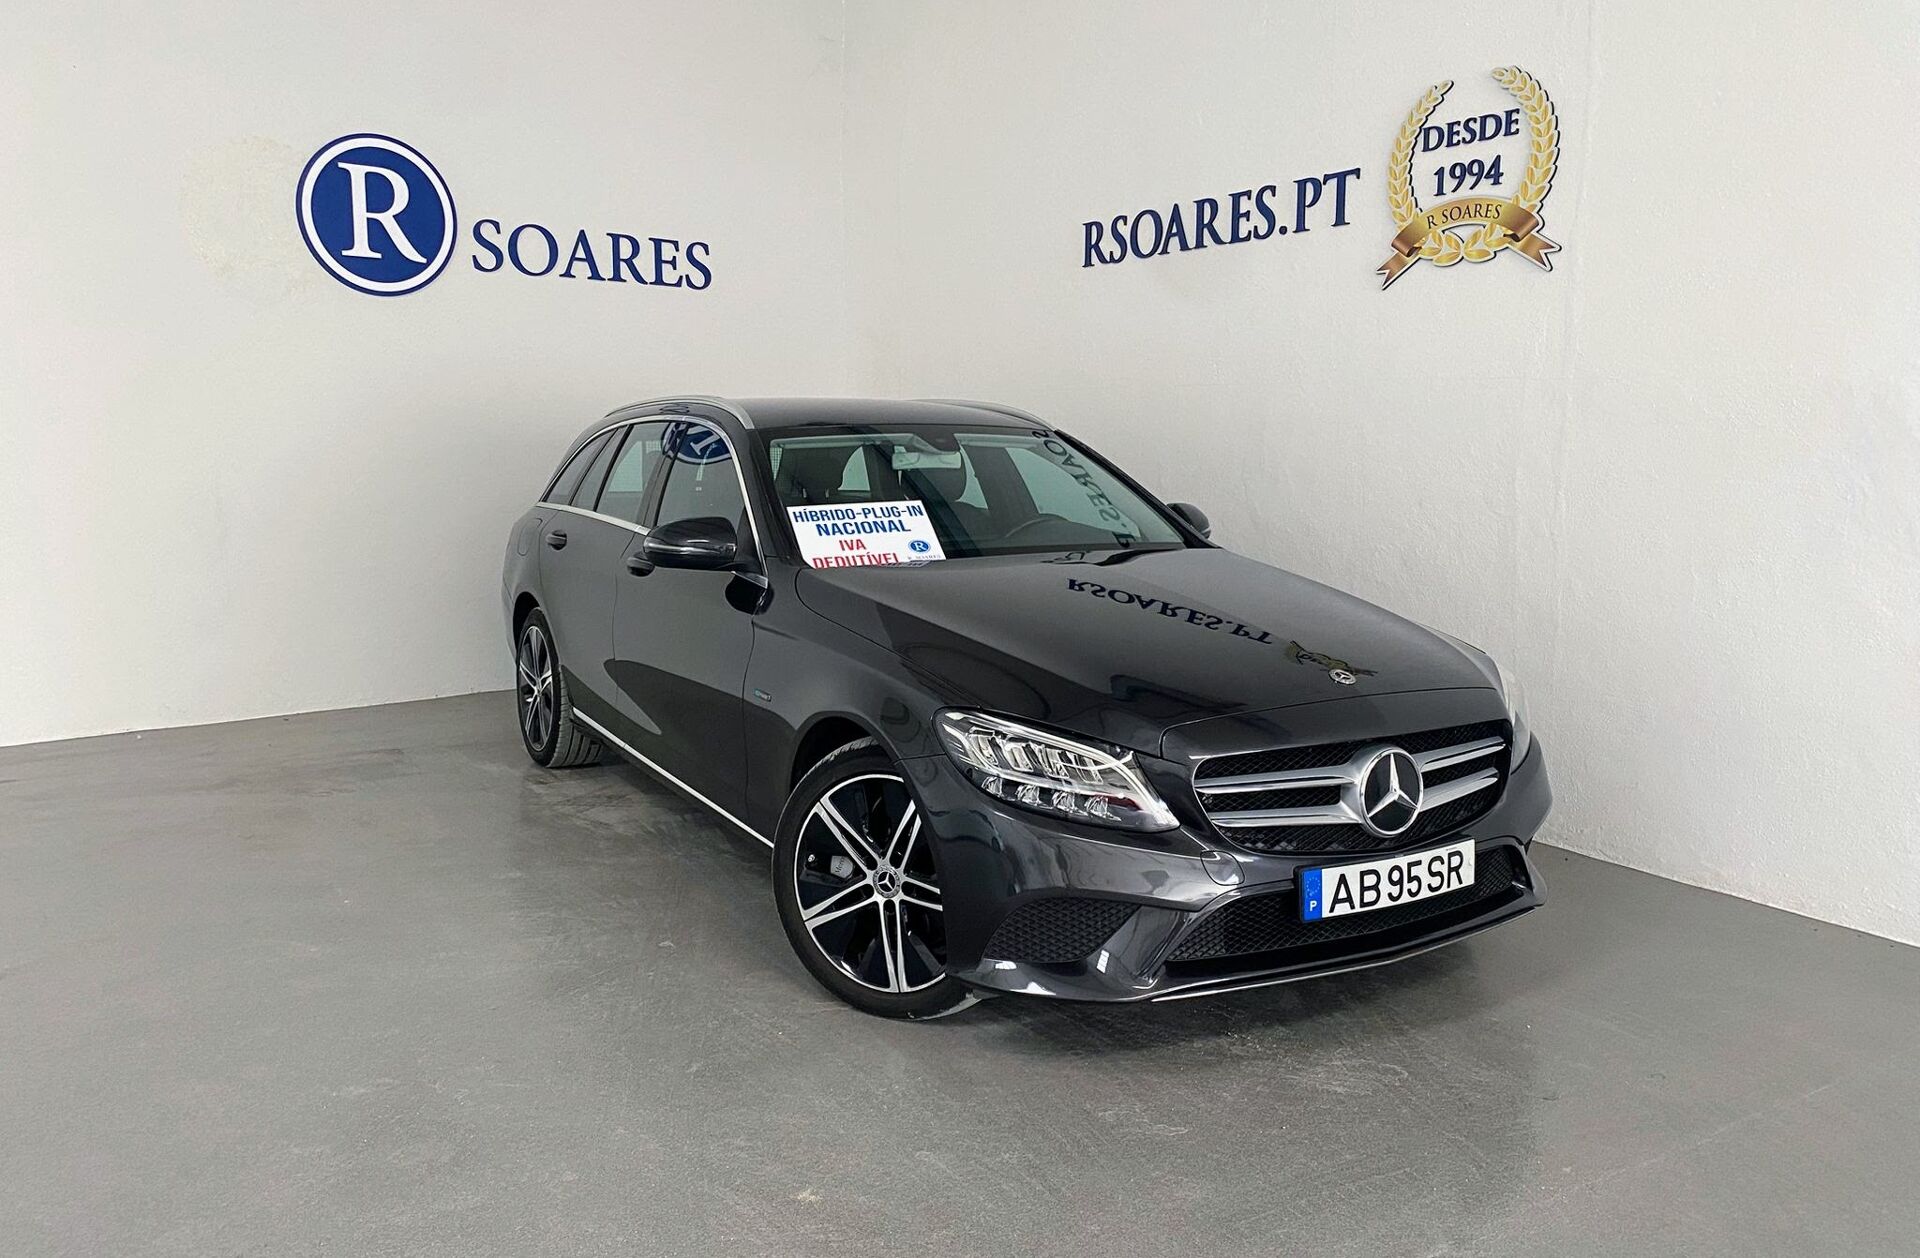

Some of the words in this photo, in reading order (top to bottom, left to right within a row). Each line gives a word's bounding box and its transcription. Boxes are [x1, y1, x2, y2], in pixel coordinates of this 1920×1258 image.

[1422, 108, 1520, 153] DESDE
[1433, 155, 1504, 197] 1994
[337, 161, 427, 264] R
[471, 218, 713, 291] SOARES
[1082, 168, 1361, 268] RSOARES.PT
[1426, 214, 1438, 229] R
[1441, 203, 1502, 224] SOARES
[792, 504, 924, 523] HÍBRIDO-PLUG-IN
[815, 519, 912, 537] NACIONAL
[839, 538, 867, 551] IVA
[1309, 900, 1318, 912] P
